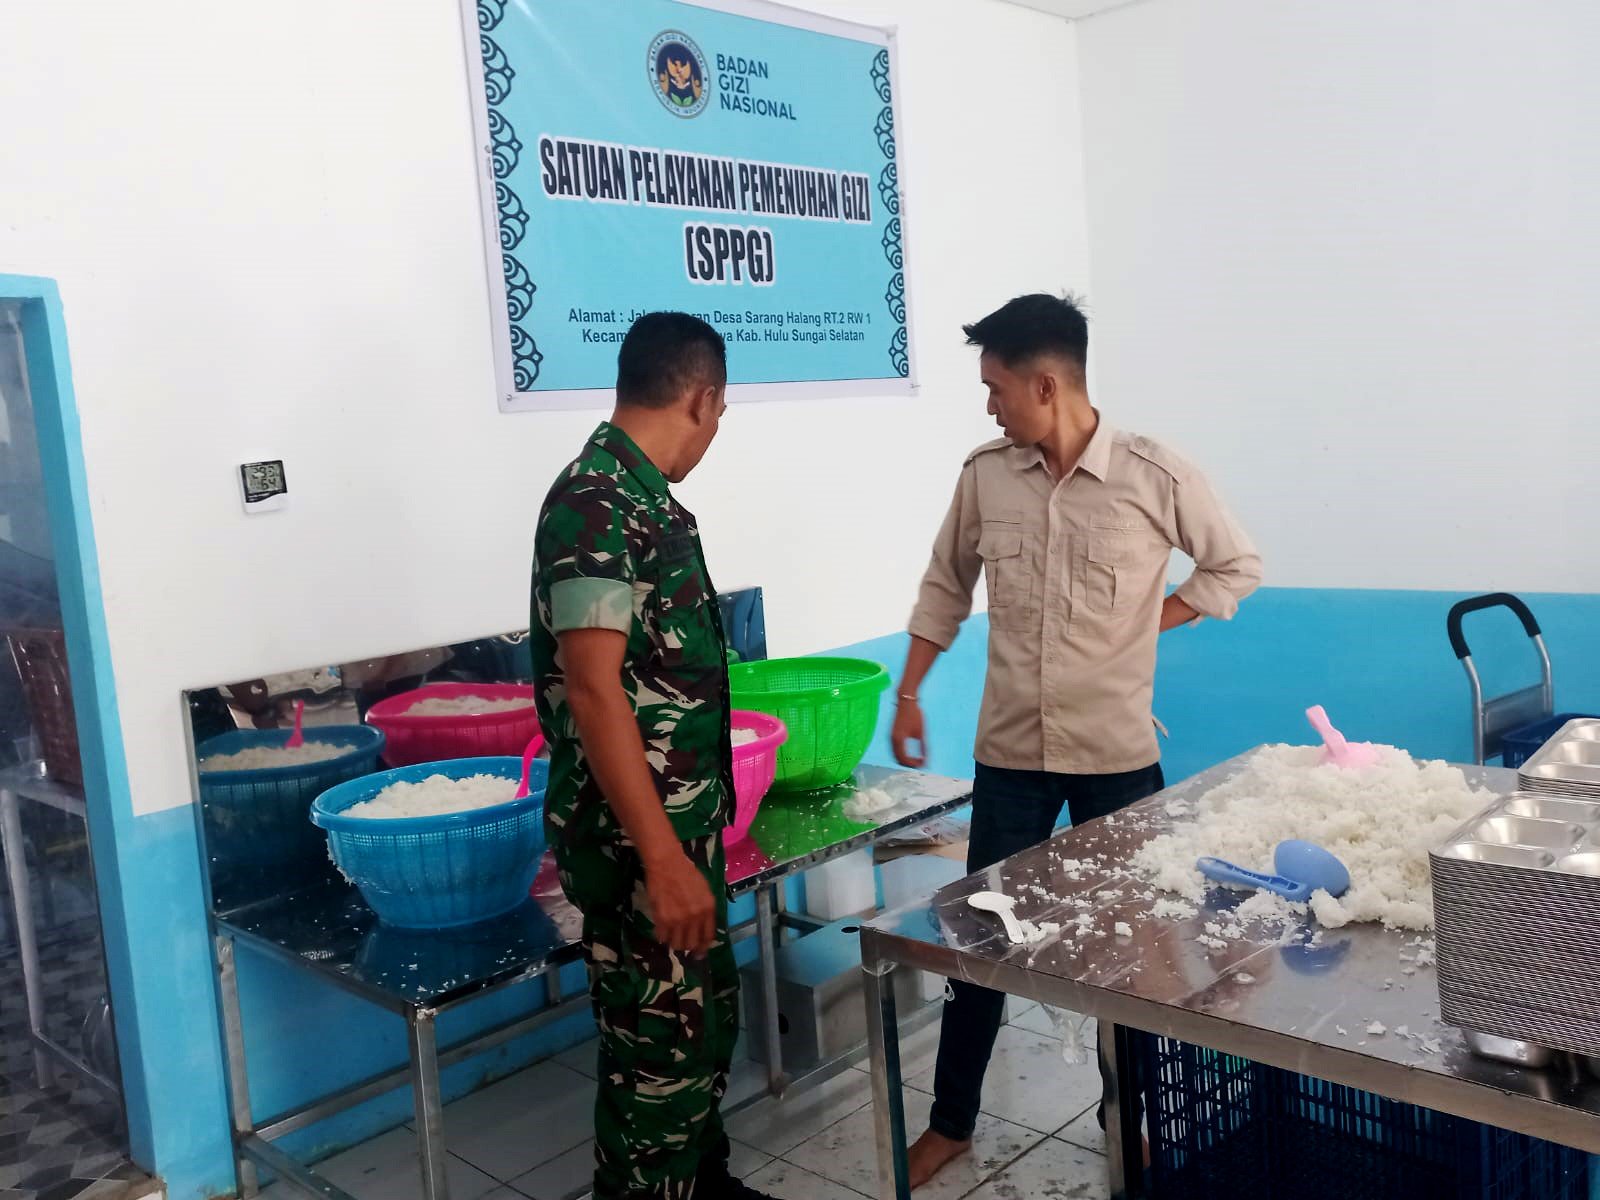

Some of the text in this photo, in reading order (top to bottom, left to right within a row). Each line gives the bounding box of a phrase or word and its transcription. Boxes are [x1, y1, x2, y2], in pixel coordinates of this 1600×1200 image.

[717, 53, 768, 79] BADAN
[719, 73, 750, 94] GIZI
[720, 92, 797, 121] NASIONAL
[540, 138, 627, 201] SATUAN
[629, 149, 737, 210] PELAYANAN
[738, 162, 839, 219] PEMENUHAN
[841, 174, 871, 221] GIZI
[685, 226, 774, 282] (SPPG)
[568, 308, 616, 323] Alamat
[714, 310, 742, 324] Desa
[745, 311, 783, 327] Sarang
[787, 312, 821, 327] Halang
[824, 312, 845, 324] RT.2
[848, 312, 864, 324] RW
[866, 313, 871, 324] 1
[736, 329, 761, 342] Kab.
[764, 329, 789, 342] Hulu
[792, 329, 827, 344] Sungai
[829, 329, 864, 341] Selatan
